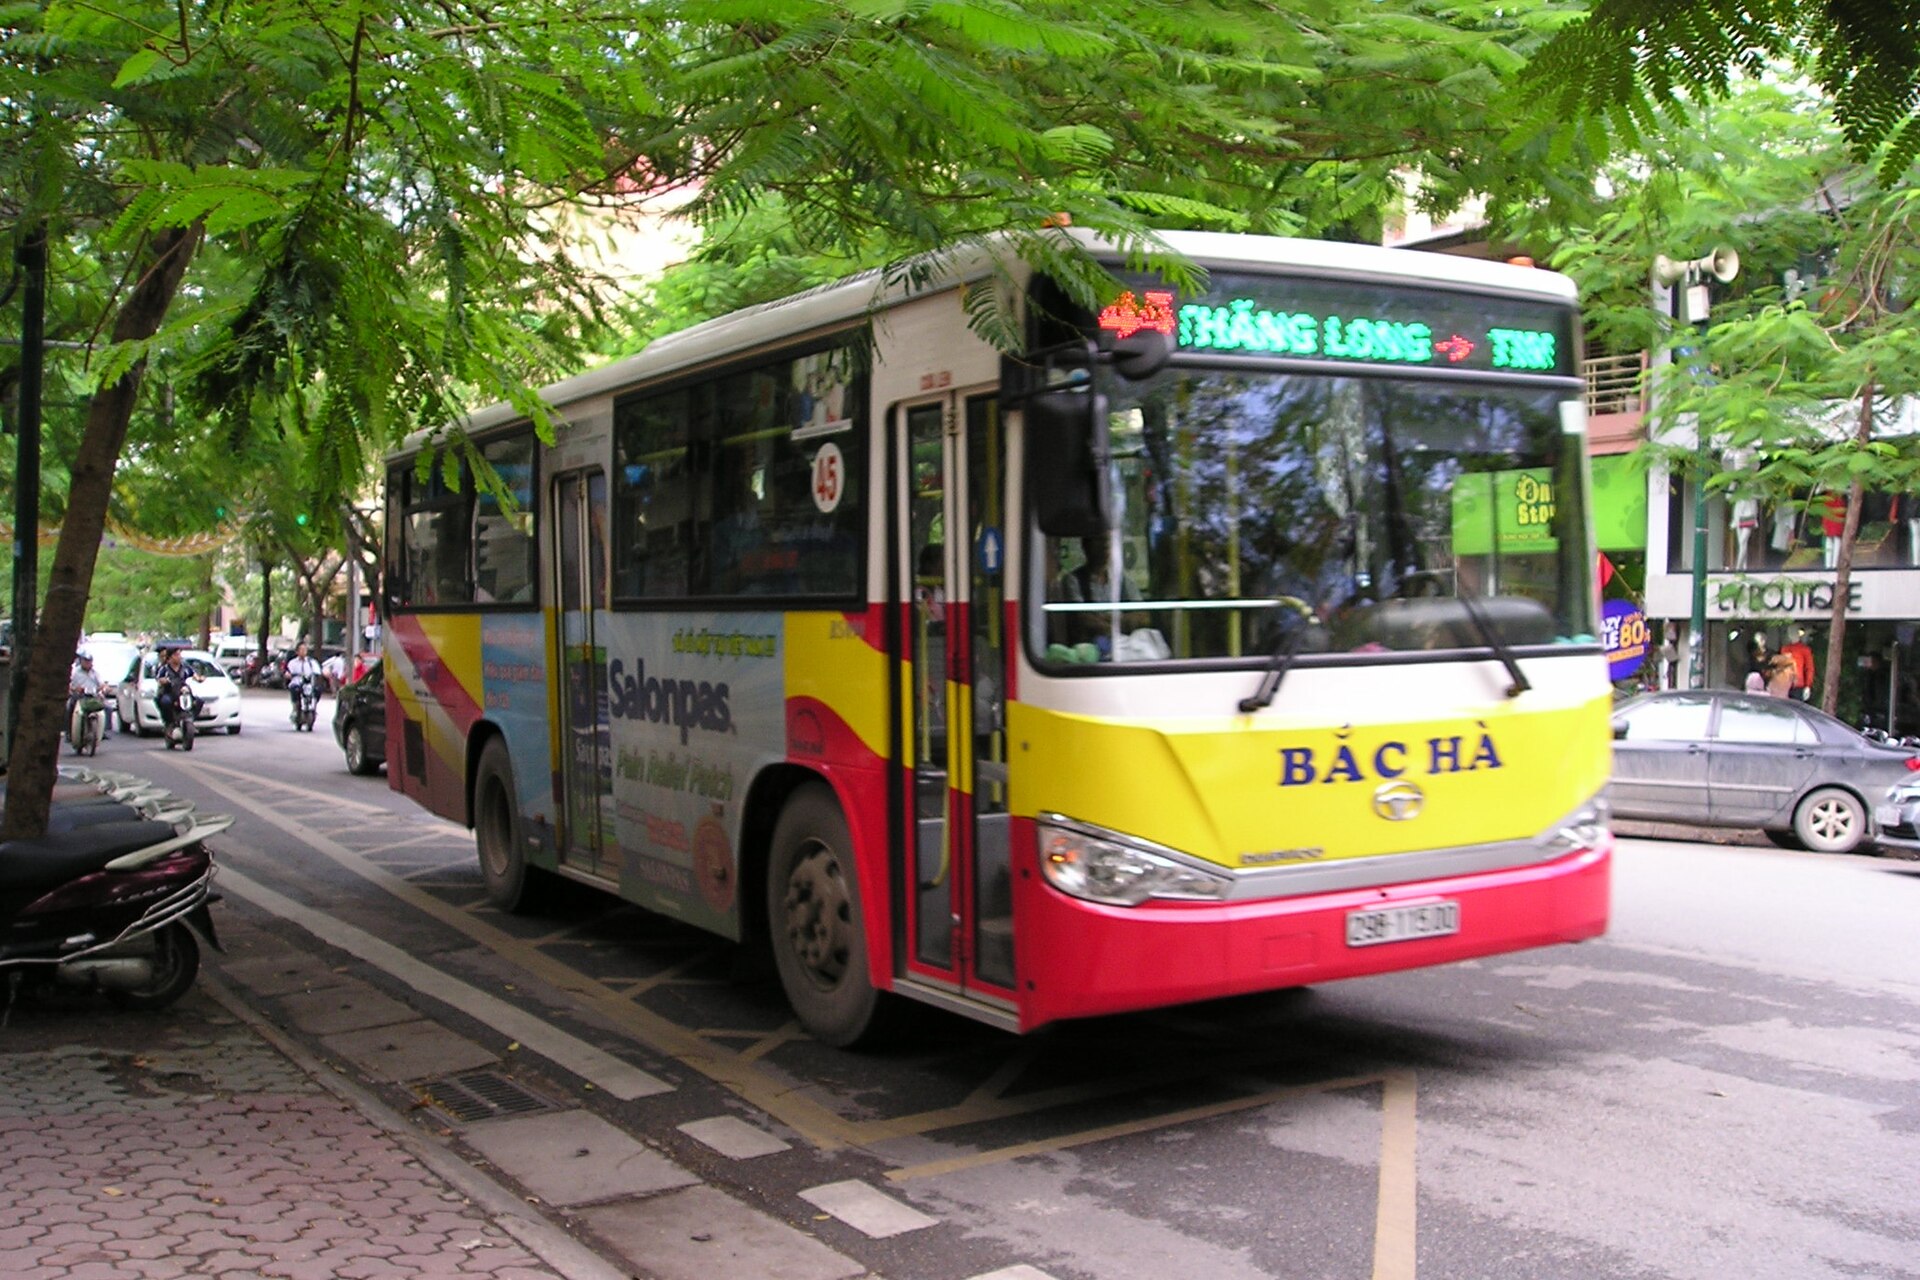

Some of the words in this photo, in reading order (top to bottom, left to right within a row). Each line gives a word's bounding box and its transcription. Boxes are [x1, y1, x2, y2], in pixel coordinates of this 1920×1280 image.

[1323, 315, 1432, 362] LONG
[816, 455, 837, 501] 45
[1749, 580, 1862, 612] BOUTIQE
[609, 657, 732, 746] Salonpas
[1278, 723, 1408, 786] BẮC
[1427, 720, 1504, 774] HÀ
